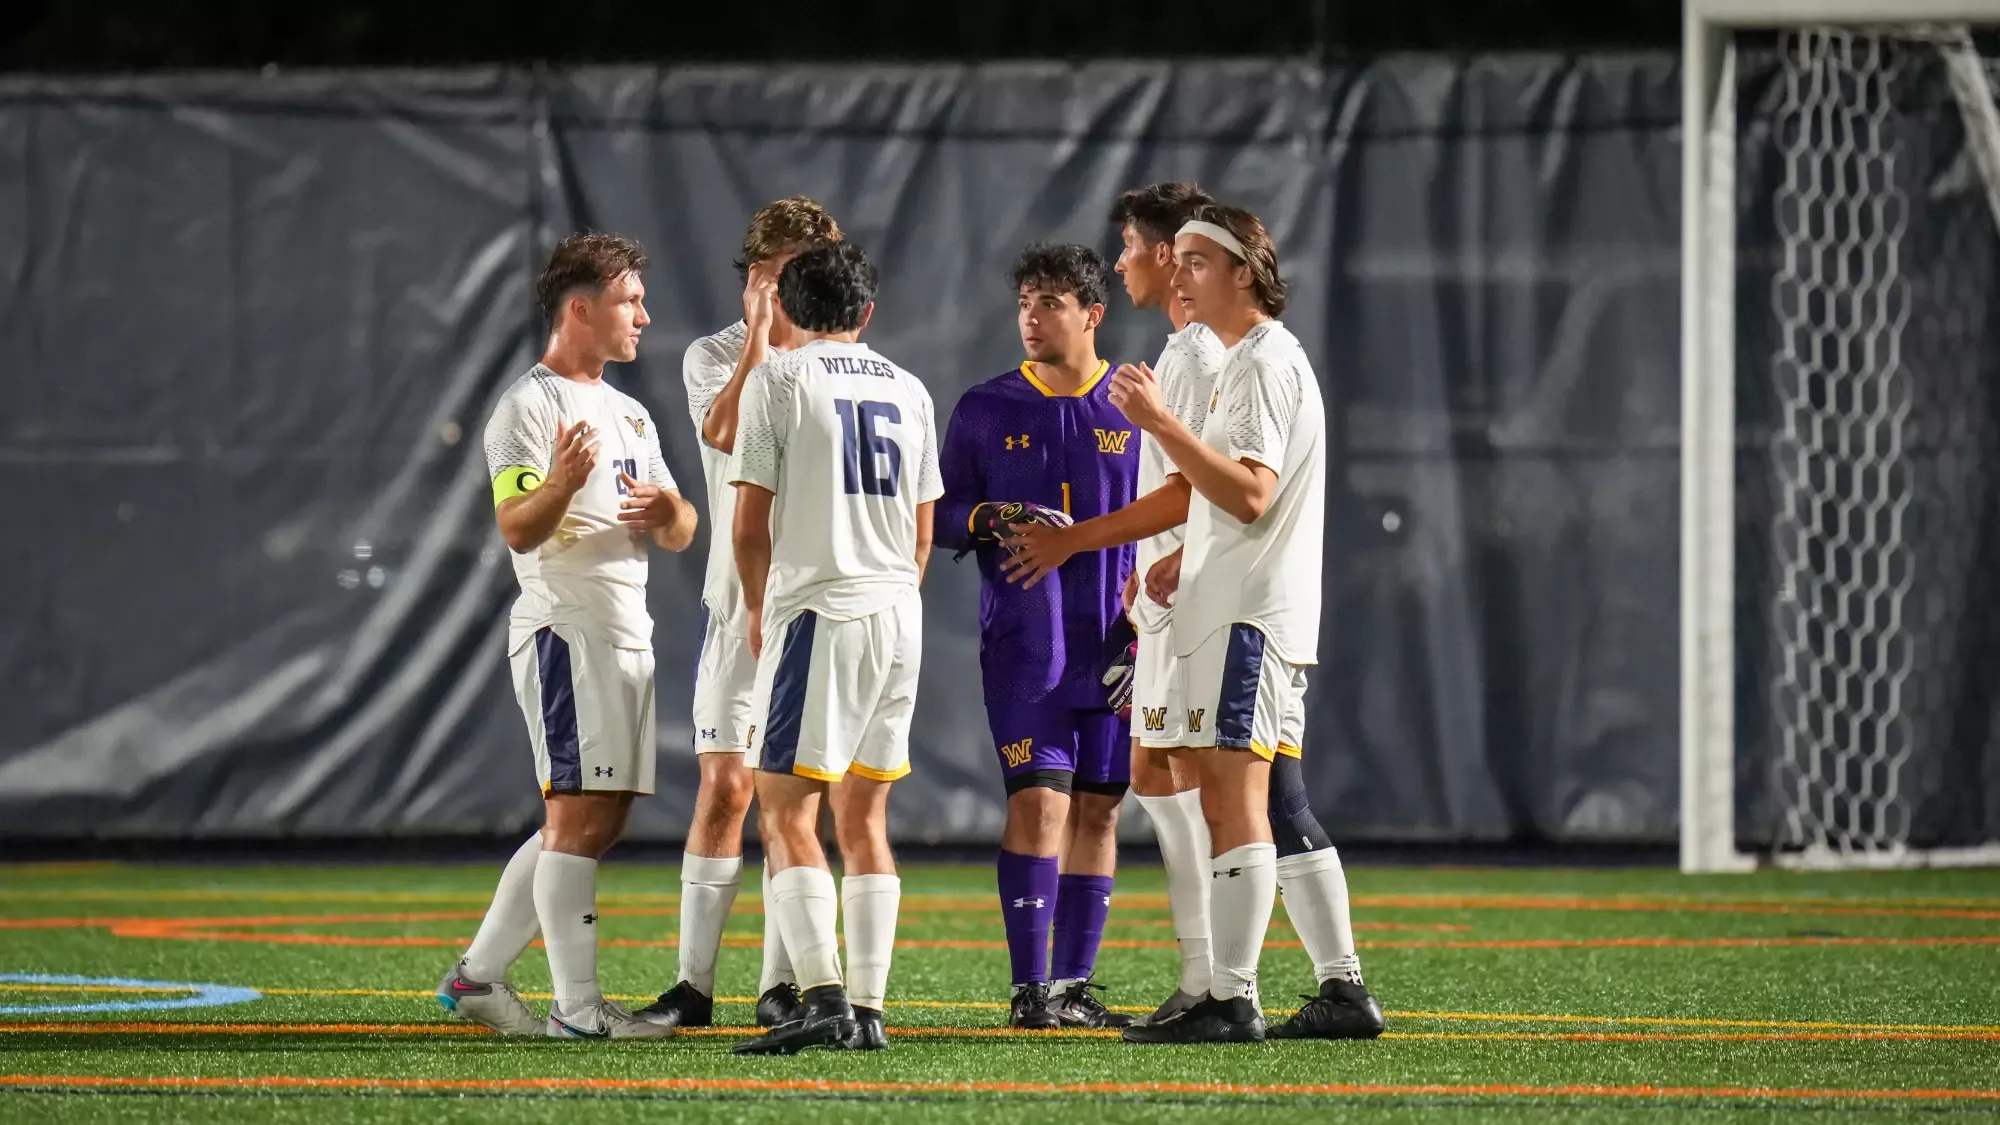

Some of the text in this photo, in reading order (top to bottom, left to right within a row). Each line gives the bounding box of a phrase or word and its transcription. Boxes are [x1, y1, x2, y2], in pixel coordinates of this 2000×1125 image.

[818, 356, 896, 380] WILKES
[834, 398, 902, 498] 16
[1093, 428, 1132, 455] W
[516, 471, 541, 493] C
[1061, 482, 1071, 516] 1
[1142, 706, 1168, 731] W
[1186, 707, 1206, 733] W
[1000, 737, 1033, 769] W
